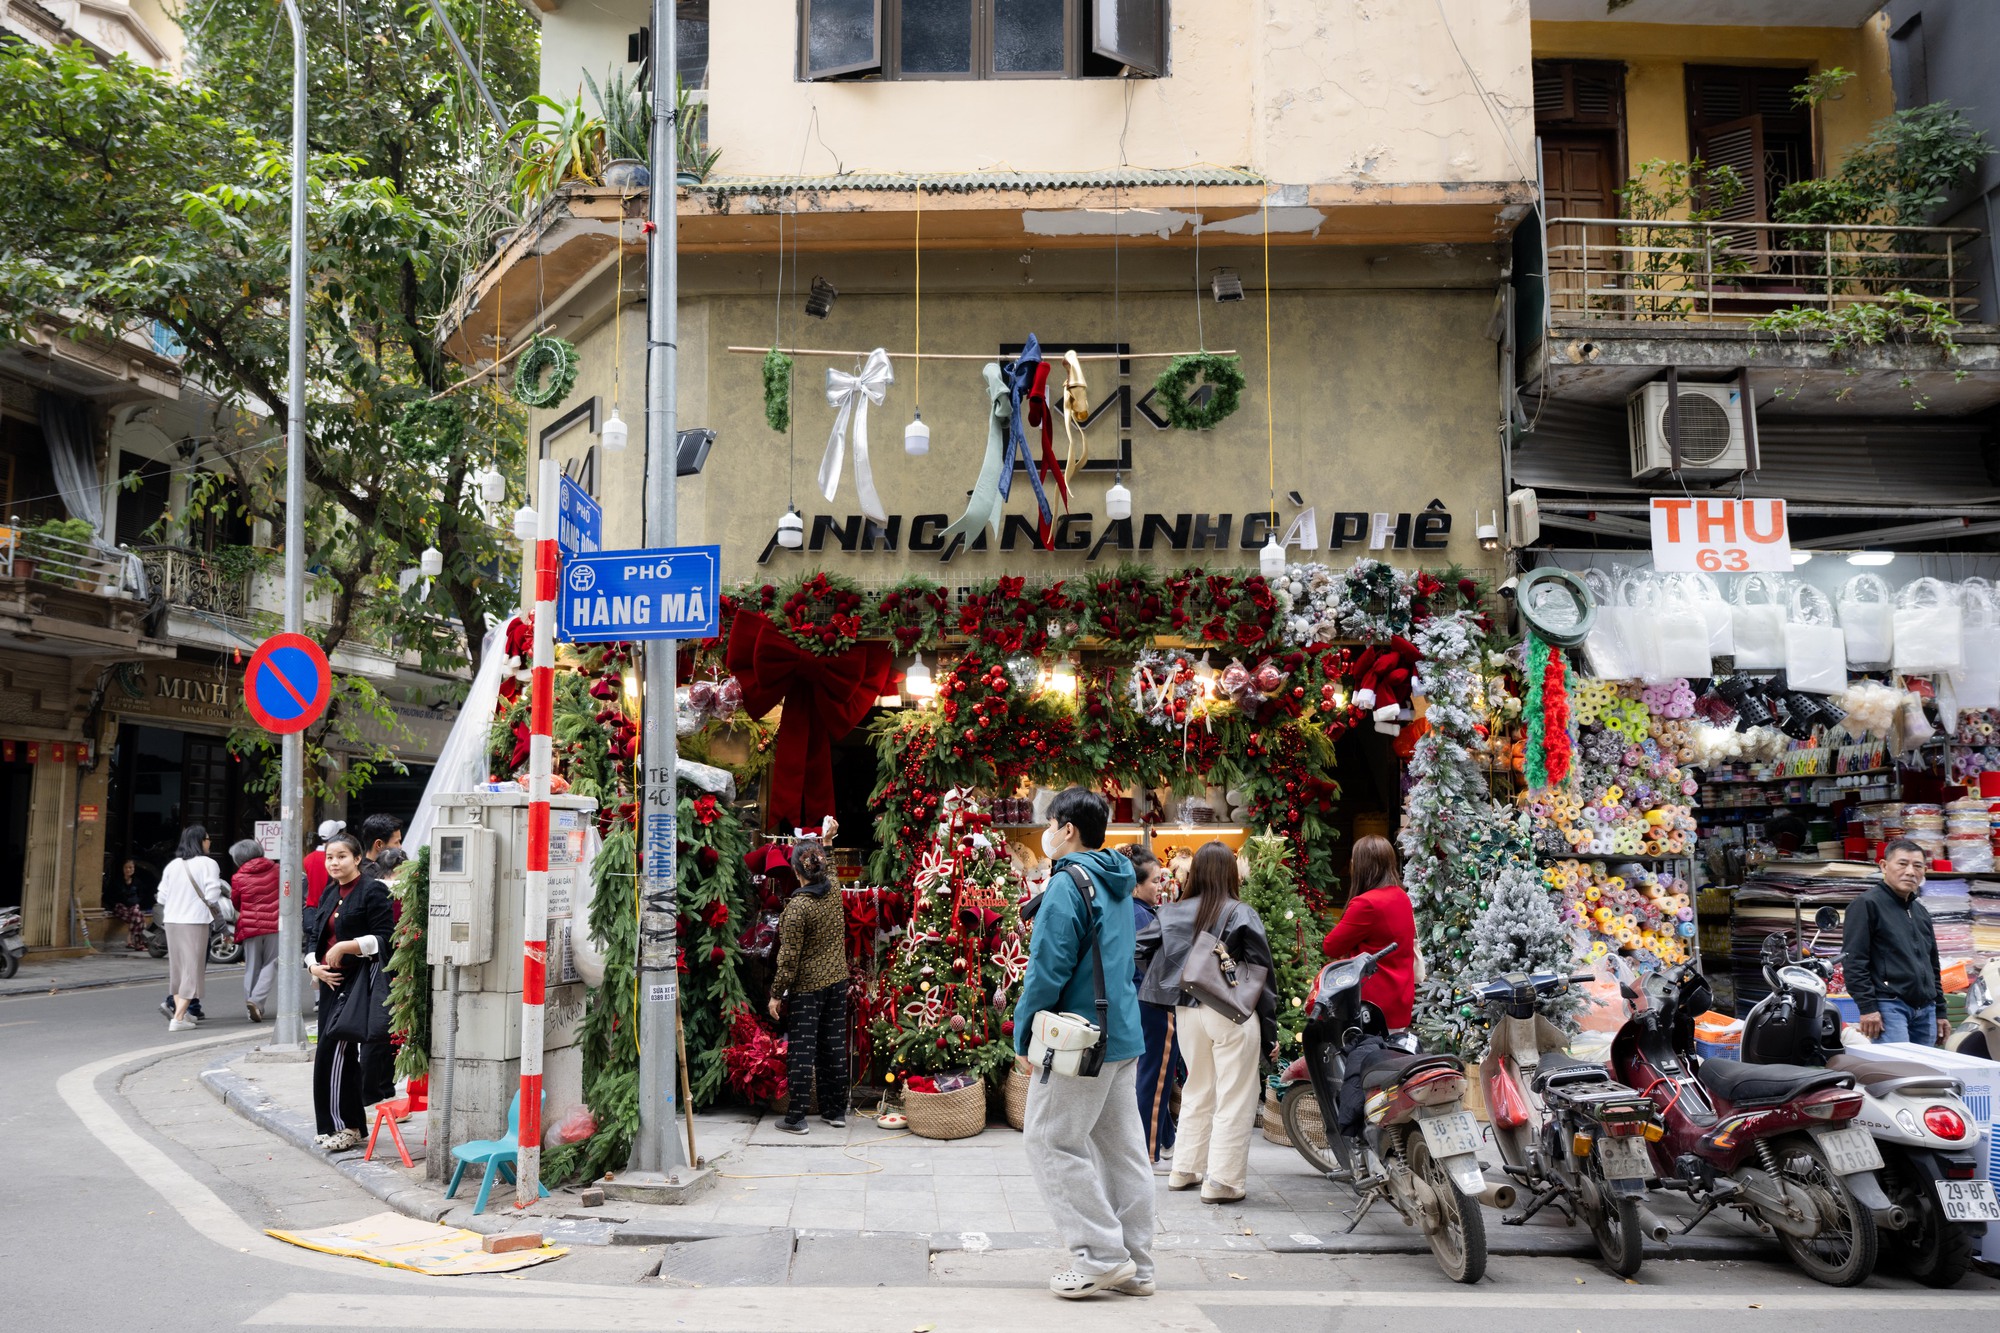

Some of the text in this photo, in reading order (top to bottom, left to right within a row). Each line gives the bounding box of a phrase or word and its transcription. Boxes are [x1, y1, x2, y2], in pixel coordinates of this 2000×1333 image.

[1086, 512, 1233, 562] ANH
[1329, 498, 1452, 550] PHÊ
[1653, 499, 1785, 544] THU
[623, 557, 675, 581] PHỐ
[1696, 548, 1750, 572] 63
[573, 586, 706, 627] HÀNG MÃ
[157, 675, 229, 706] MINH
[181, 704, 237, 719] KINH DOAH
[649, 767, 670, 783] TB
[960, 896, 1009, 907] Christmas
[1964, 1085, 1991, 1093] asis
[1849, 1118, 1891, 1130] COOPY
[1829, 1131, 1868, 1152] 17-L1
[1835, 1149, 1876, 1171] 7503
[1944, 1183, 1986, 1200] 29-BF
